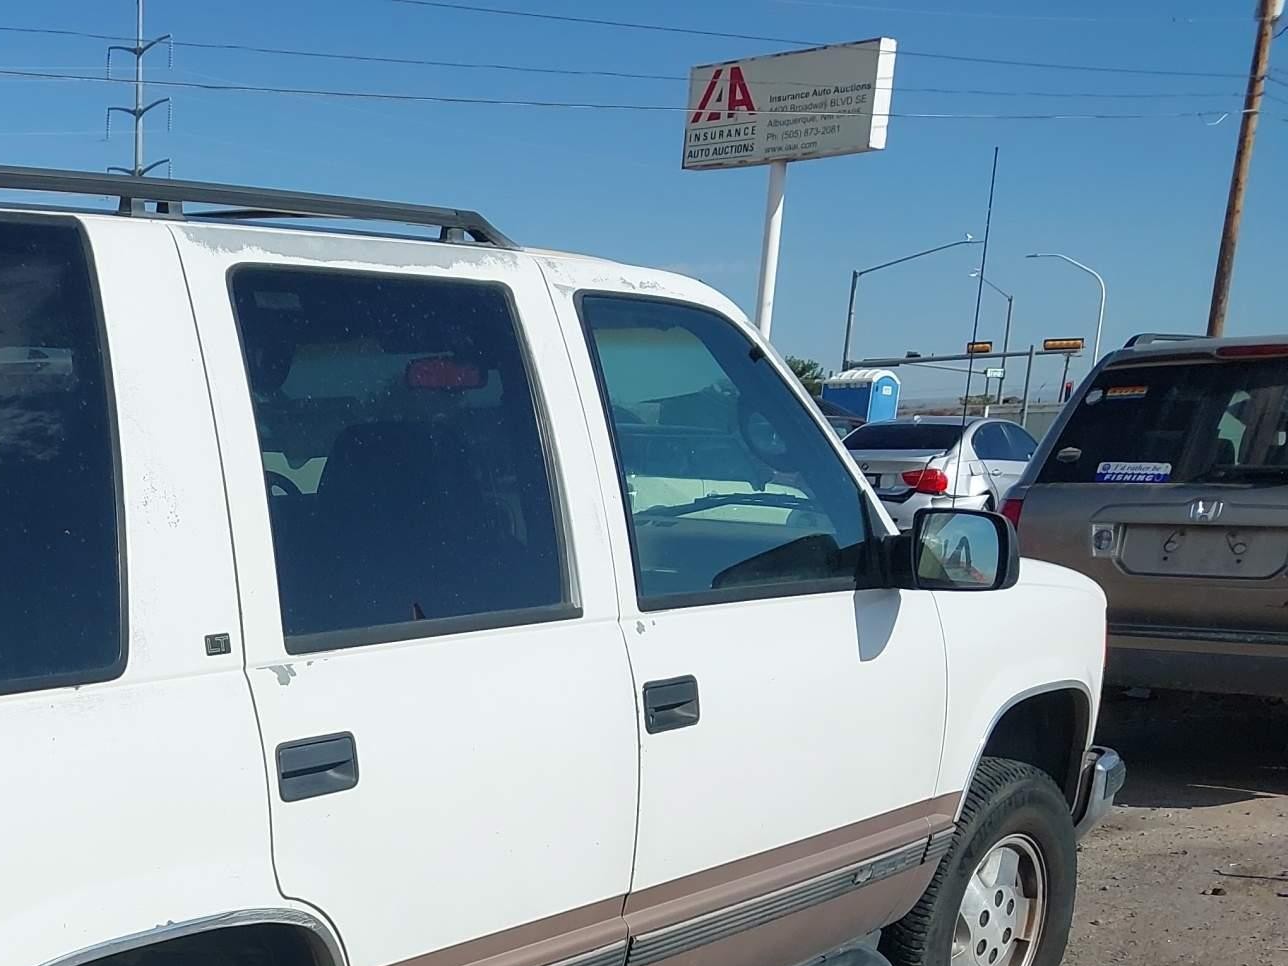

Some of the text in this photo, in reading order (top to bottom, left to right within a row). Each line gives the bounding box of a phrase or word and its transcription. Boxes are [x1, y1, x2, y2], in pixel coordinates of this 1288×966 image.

[769, 82, 872, 103] Insurance Auto Auctions
[829, 96, 853, 108] BLVD
[855, 93, 868, 104] SE
[688, 125, 757, 144] INSURANCE
[687, 142, 755, 159] AUTO AUCTIONS
[1103, 473, 1154, 481] FISHING
[206, 634, 229, 654] LT
